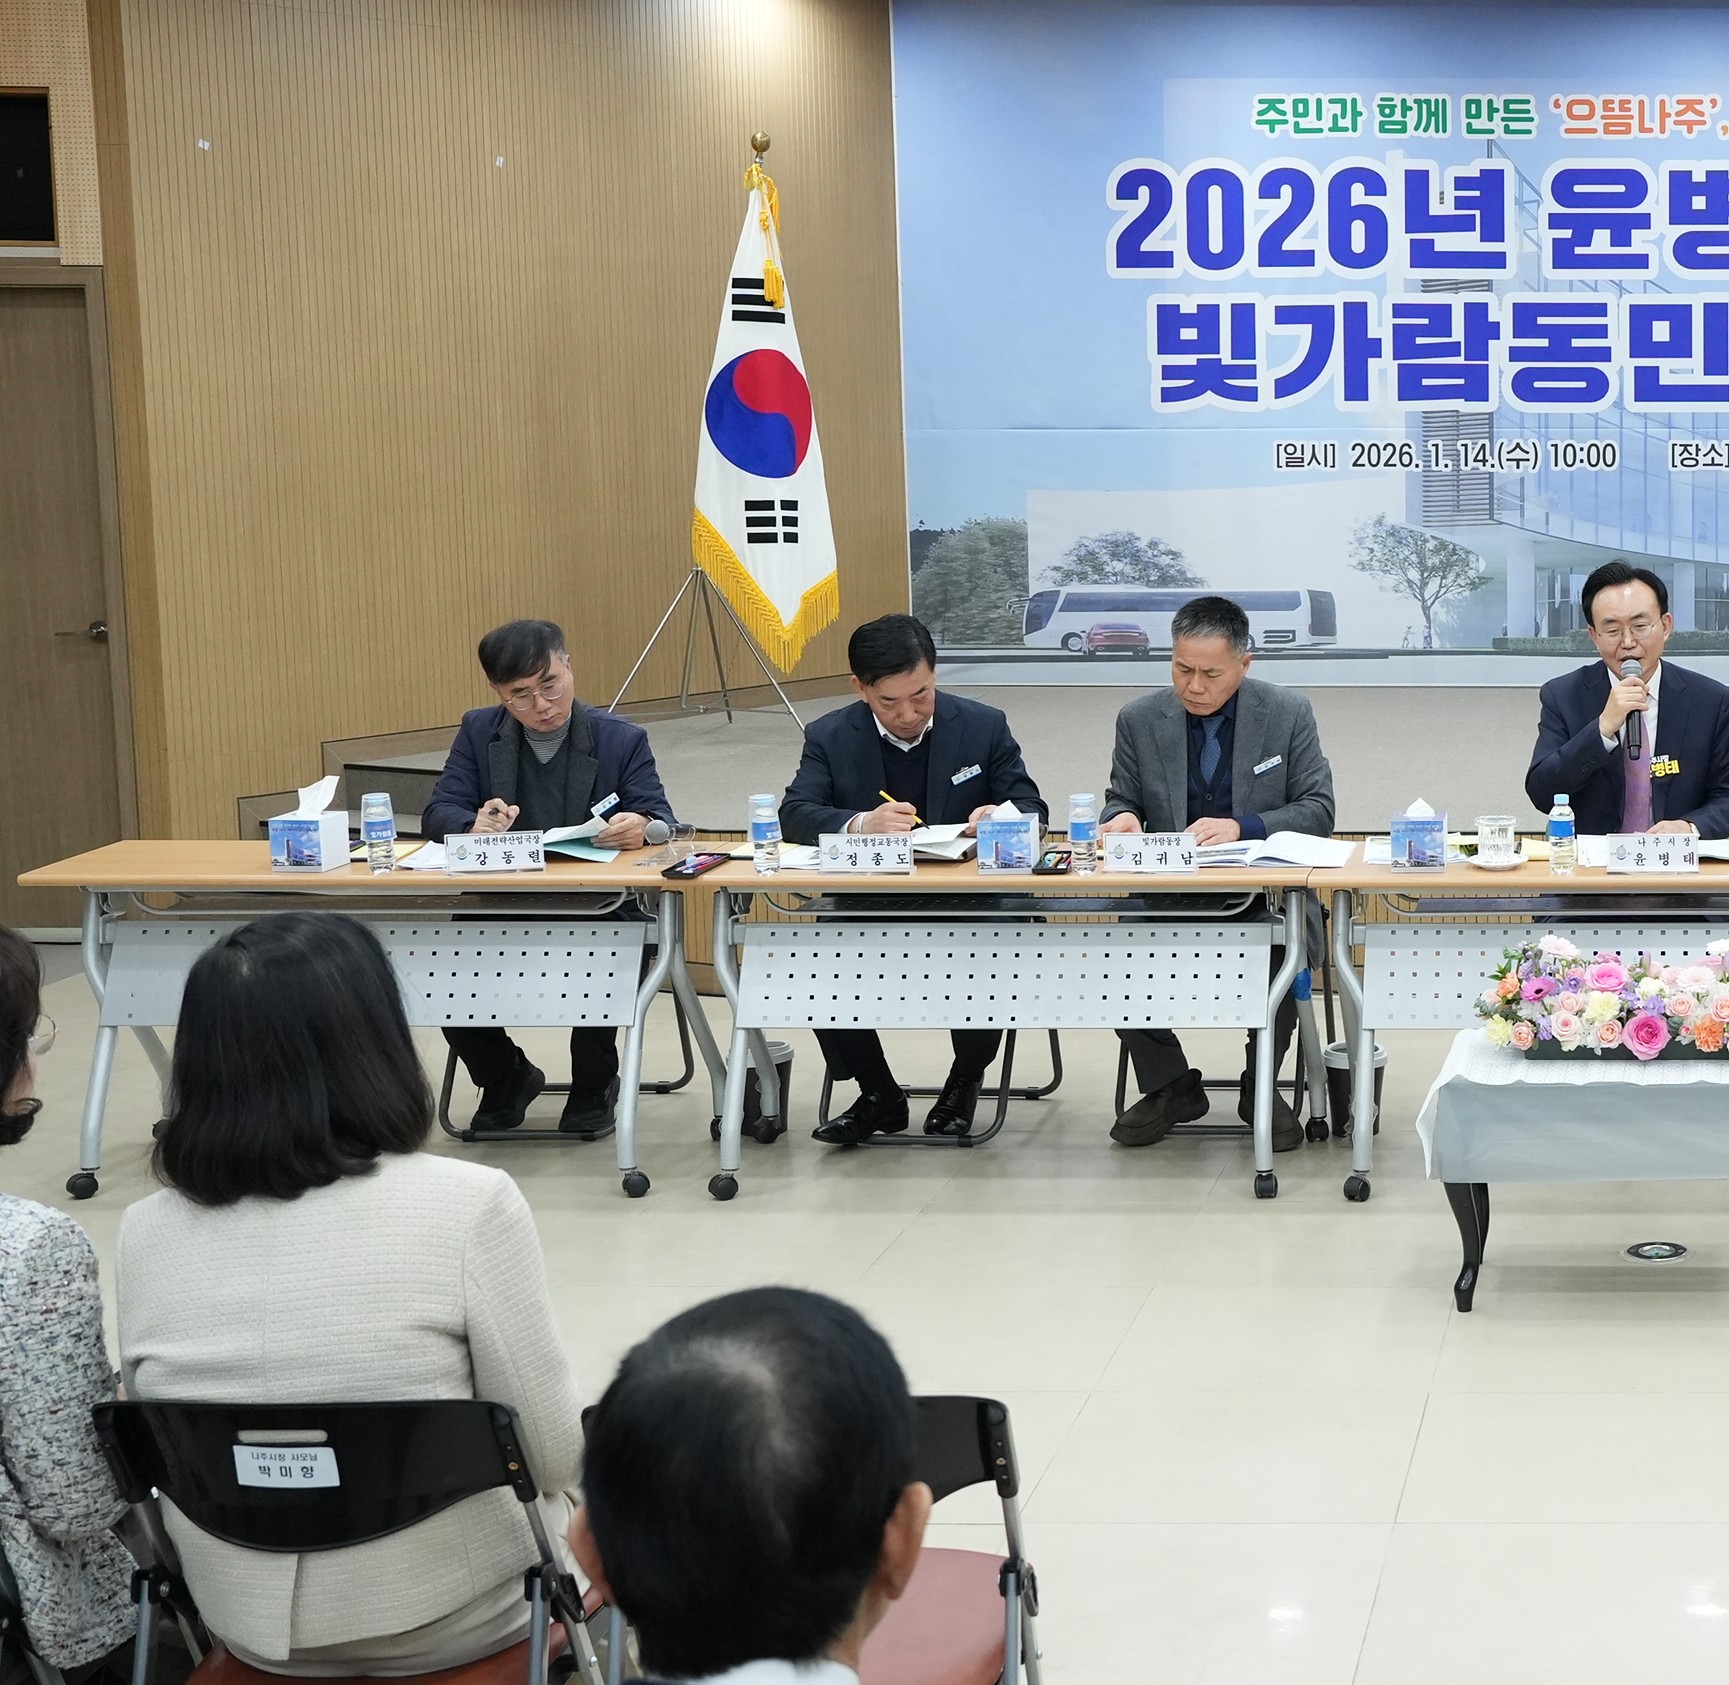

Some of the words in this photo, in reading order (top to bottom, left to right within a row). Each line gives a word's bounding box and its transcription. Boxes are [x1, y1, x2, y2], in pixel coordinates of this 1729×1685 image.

[1256, 97, 1363, 135] 주민과
[1376, 97, 1448, 135] 함께
[1465, 98, 1536, 135] 만든
[1114, 166, 1507, 270] 2026년
[1276, 442, 1336, 469] [일시]
[1352, 443, 1420, 469] 2026.
[1549, 443, 1617, 469] 10:00
[1650, 760, 1680, 777] 병태
[474, 835, 540, 846] 미래전략산업국장
[1142, 837, 1181, 846] 빛가람동장
